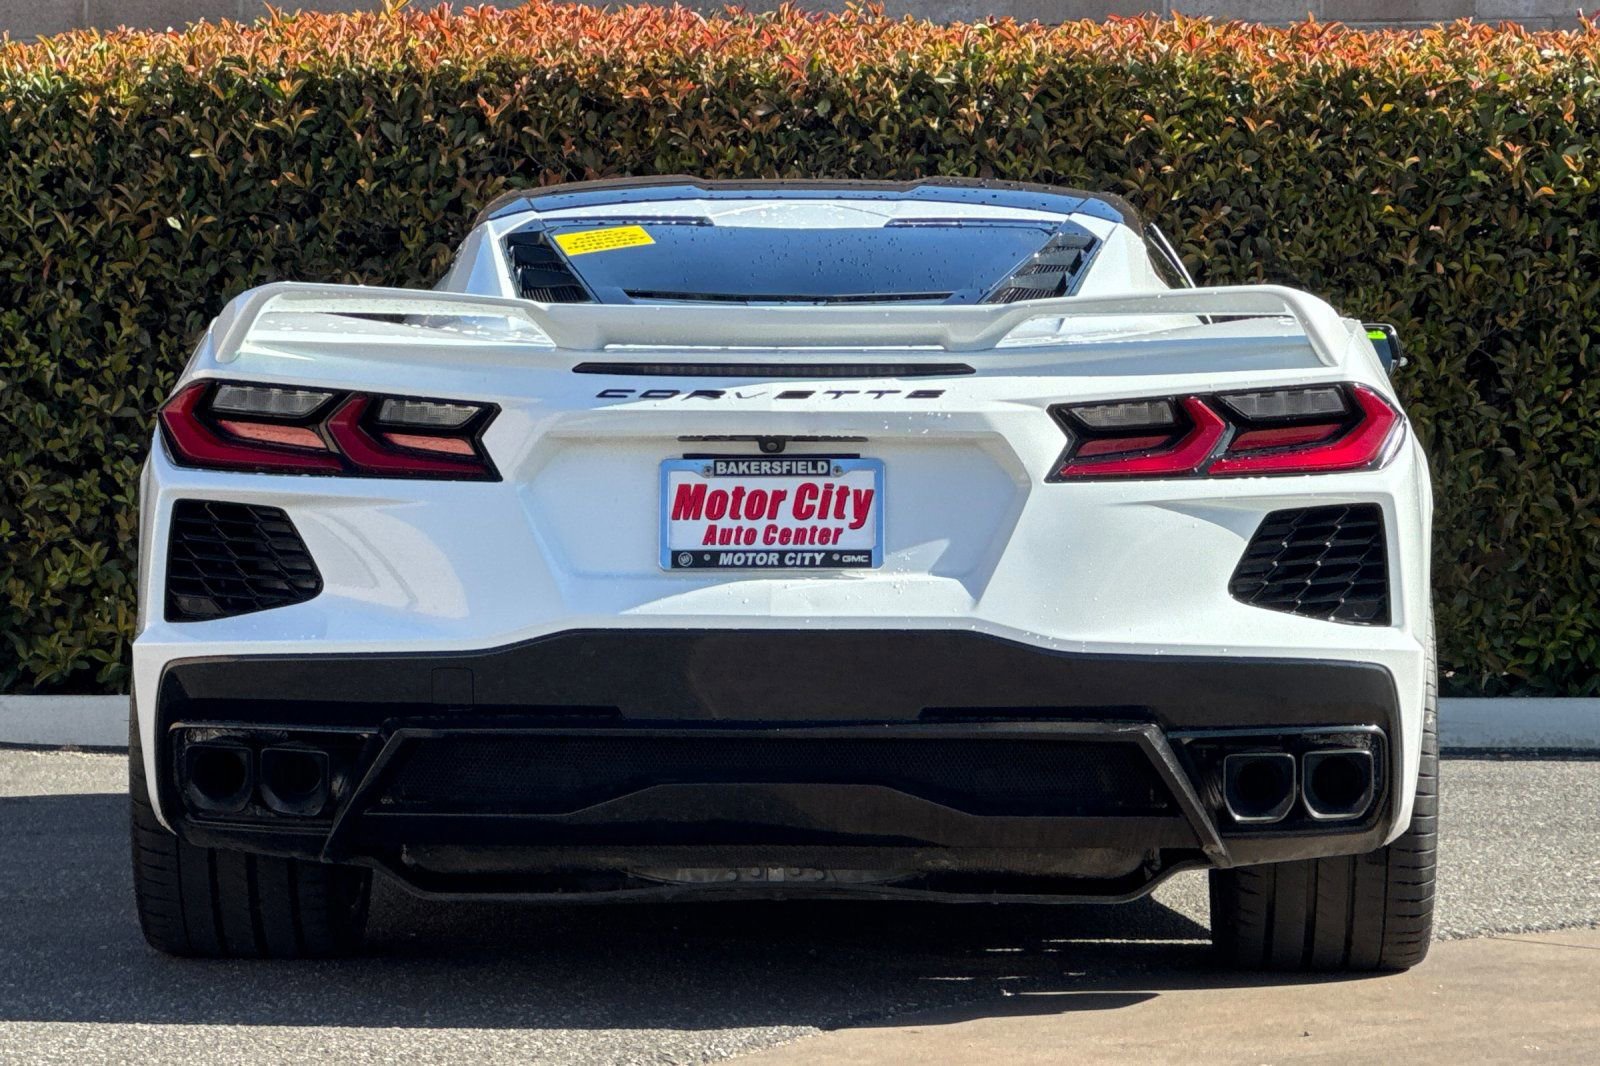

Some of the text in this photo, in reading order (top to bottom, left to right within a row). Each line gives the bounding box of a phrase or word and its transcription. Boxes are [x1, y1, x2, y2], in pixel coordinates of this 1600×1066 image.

[596, 389, 947, 401] CORVETTE
[716, 461, 828, 475] BAKERSFIELD
[672, 482, 875, 530] Motor City
[702, 523, 844, 546] Auto Center
[719, 552, 869, 566] MOTOR CITY GMC
